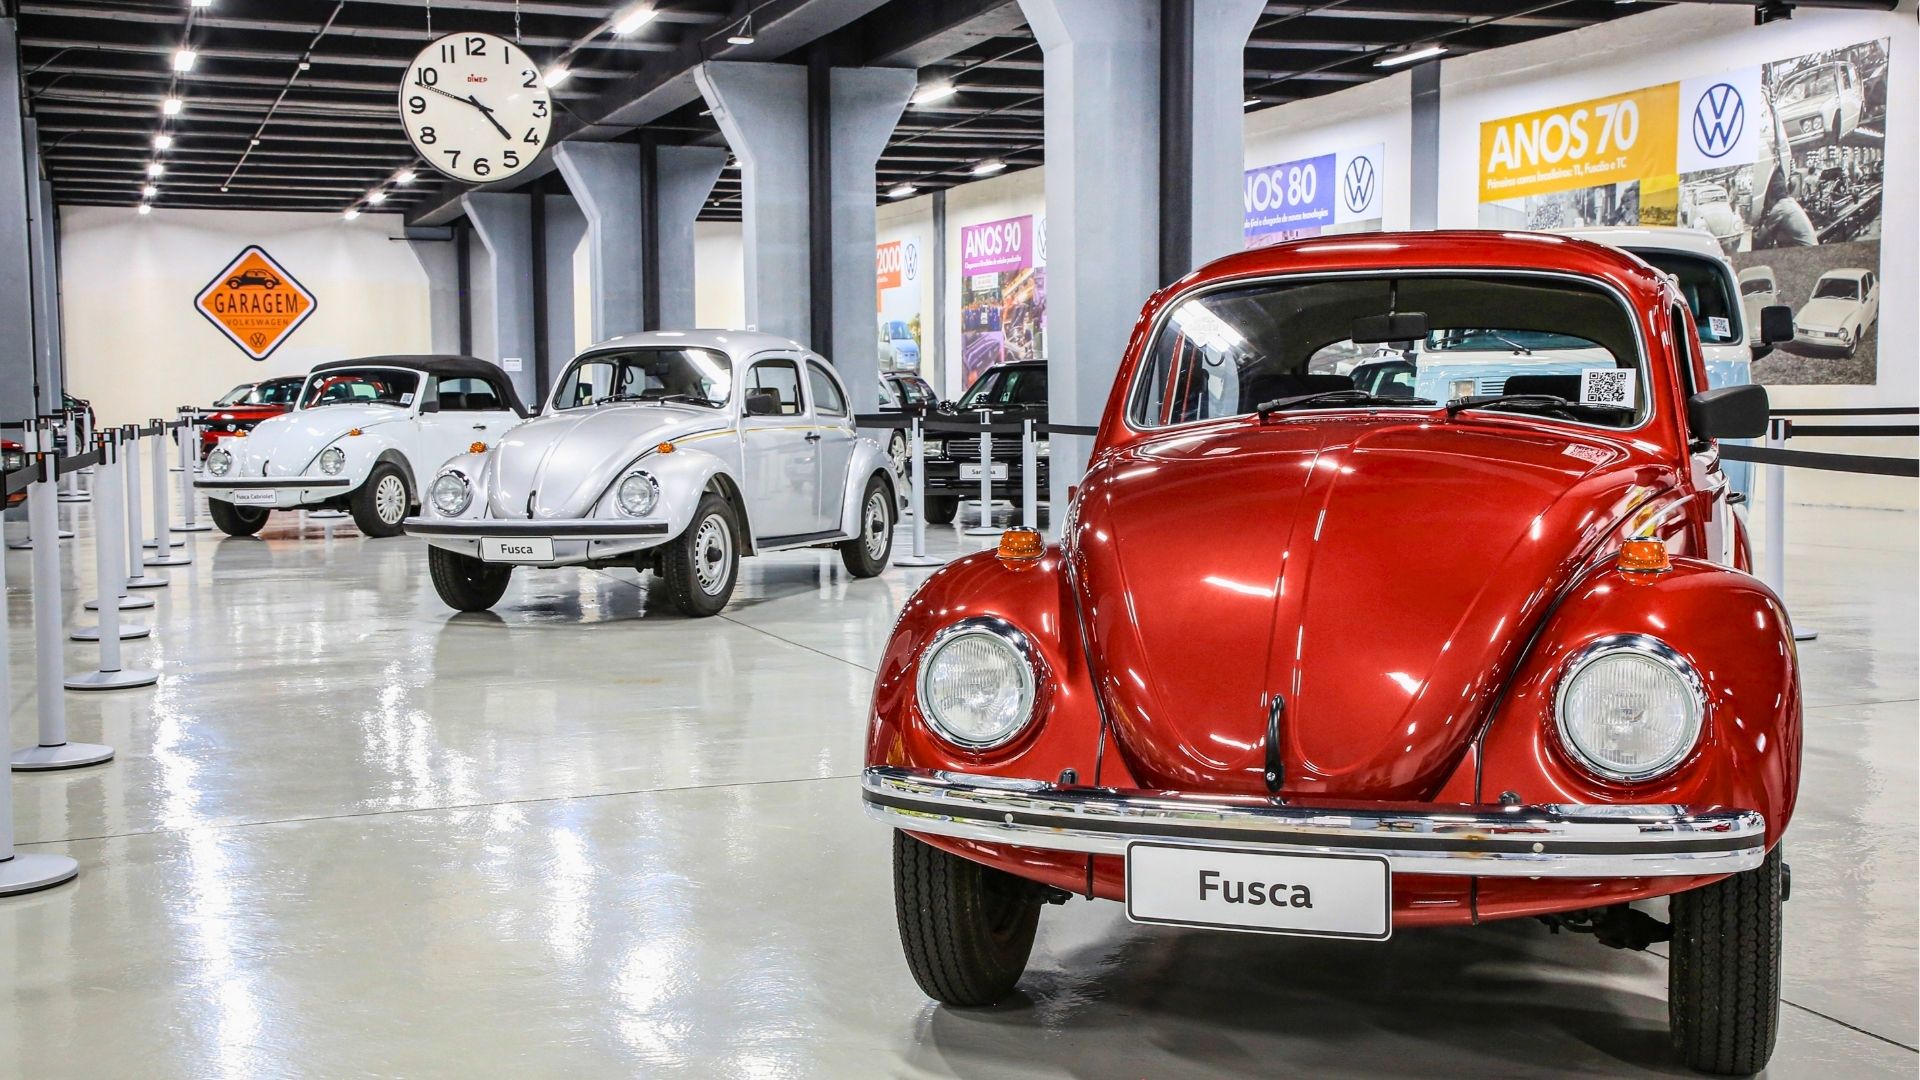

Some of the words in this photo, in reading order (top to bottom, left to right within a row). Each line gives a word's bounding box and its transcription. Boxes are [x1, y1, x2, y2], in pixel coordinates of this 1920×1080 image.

[441, 44, 456, 64] 11
[465, 37, 487, 56] 12
[504, 46, 510, 65] 1
[418, 67, 438, 86] 10
[521, 69, 537, 88] 2
[409, 96, 427, 115] 9
[532, 100, 548, 119] 3
[419, 126, 437, 145] 8
[523, 127, 540, 146] 4
[1487, 109, 1589, 173] ANOS
[1594, 99, 1640, 155] 70
[443, 150, 461, 169] 7
[473, 158, 491, 176] 6
[503, 150, 520, 169] 5
[1287, 163, 1317, 207] 80
[964, 226, 1002, 259] ANOS
[1004, 221, 1021, 253] 90
[877, 245, 901, 274] 2000
[214, 292, 298, 313] GARAGEM
[226, 318, 289, 326] VOLKSWAGEN
[500, 543, 534, 554] Fusca
[1199, 869, 1313, 909] Fusca
